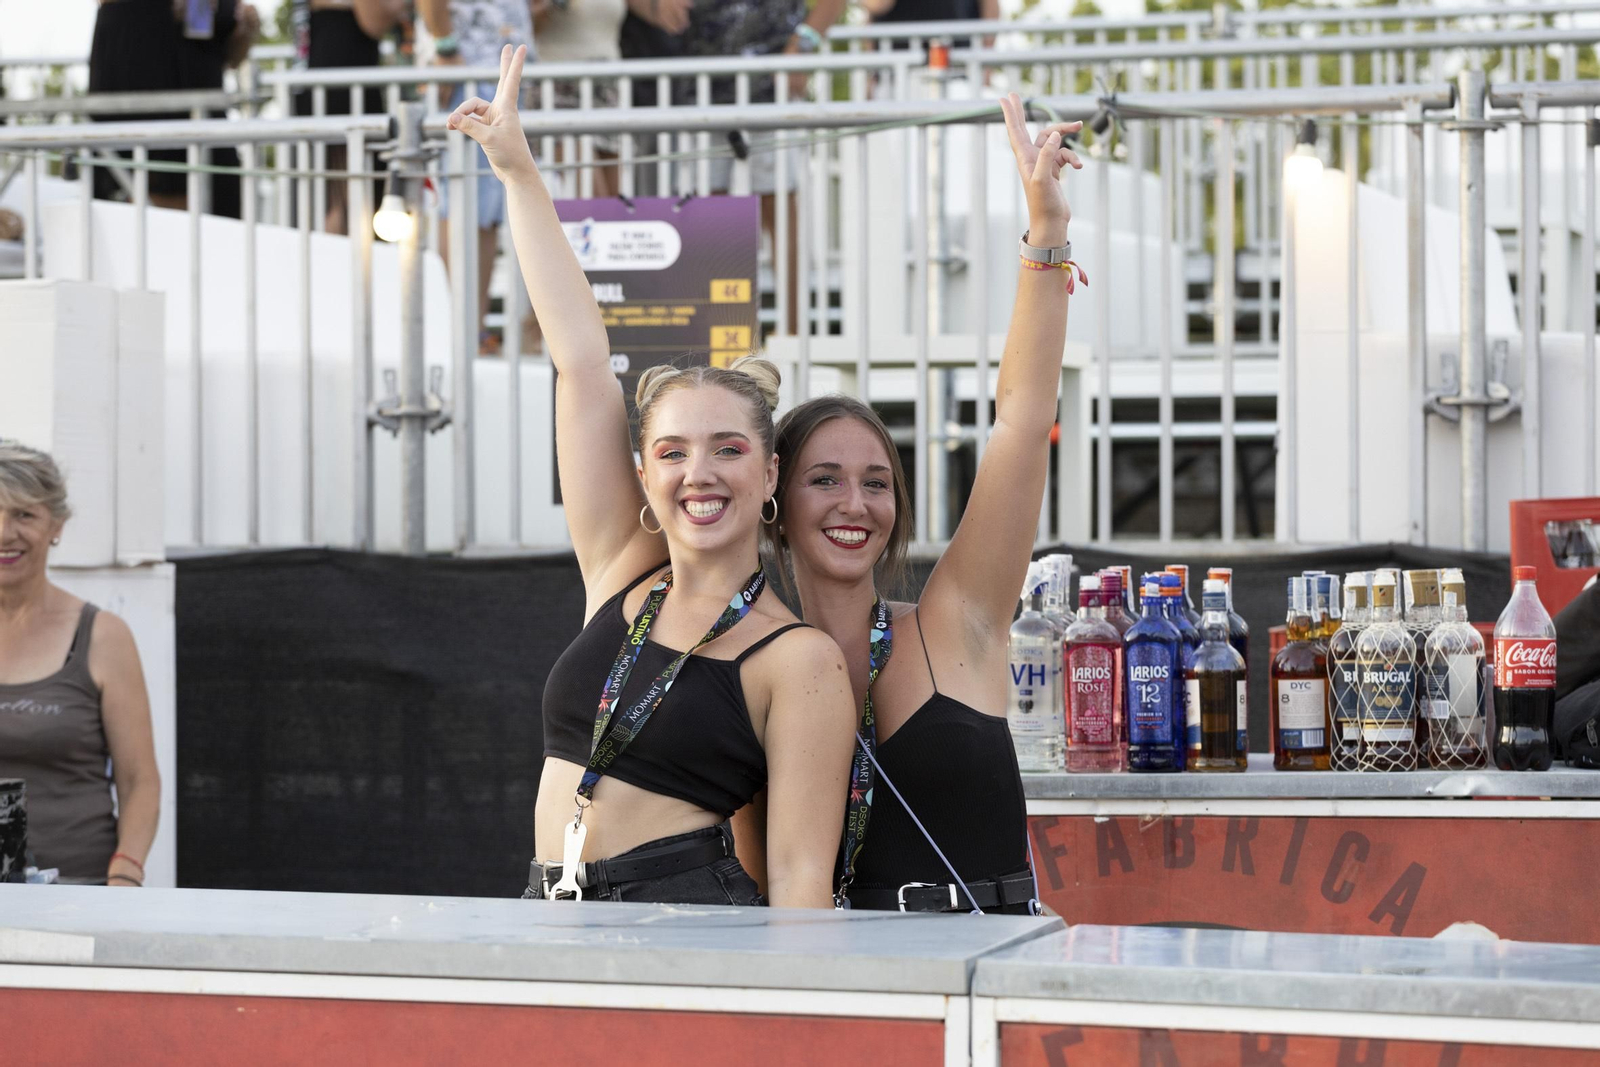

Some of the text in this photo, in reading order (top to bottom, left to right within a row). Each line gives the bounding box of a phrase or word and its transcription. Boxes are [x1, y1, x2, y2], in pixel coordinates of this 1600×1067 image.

[610, 655, 632, 694] MOMART
[1010, 663, 1046, 686] VH
[1072, 666, 1111, 683] LARIOS
[1130, 665, 1169, 683] LARIOS
[1363, 671, 1411, 684] BRUGAL
[1136, 683, 1161, 703] 12
[1290, 681, 1312, 690] DYC
[628, 685, 662, 723] MOMART
[1281, 693, 1290, 704] 8
[589, 740, 613, 768] DSOKO
[599, 750, 618, 768] FEST
[848, 811, 858, 833] FEST
[856, 806, 868, 840] DSOKO
